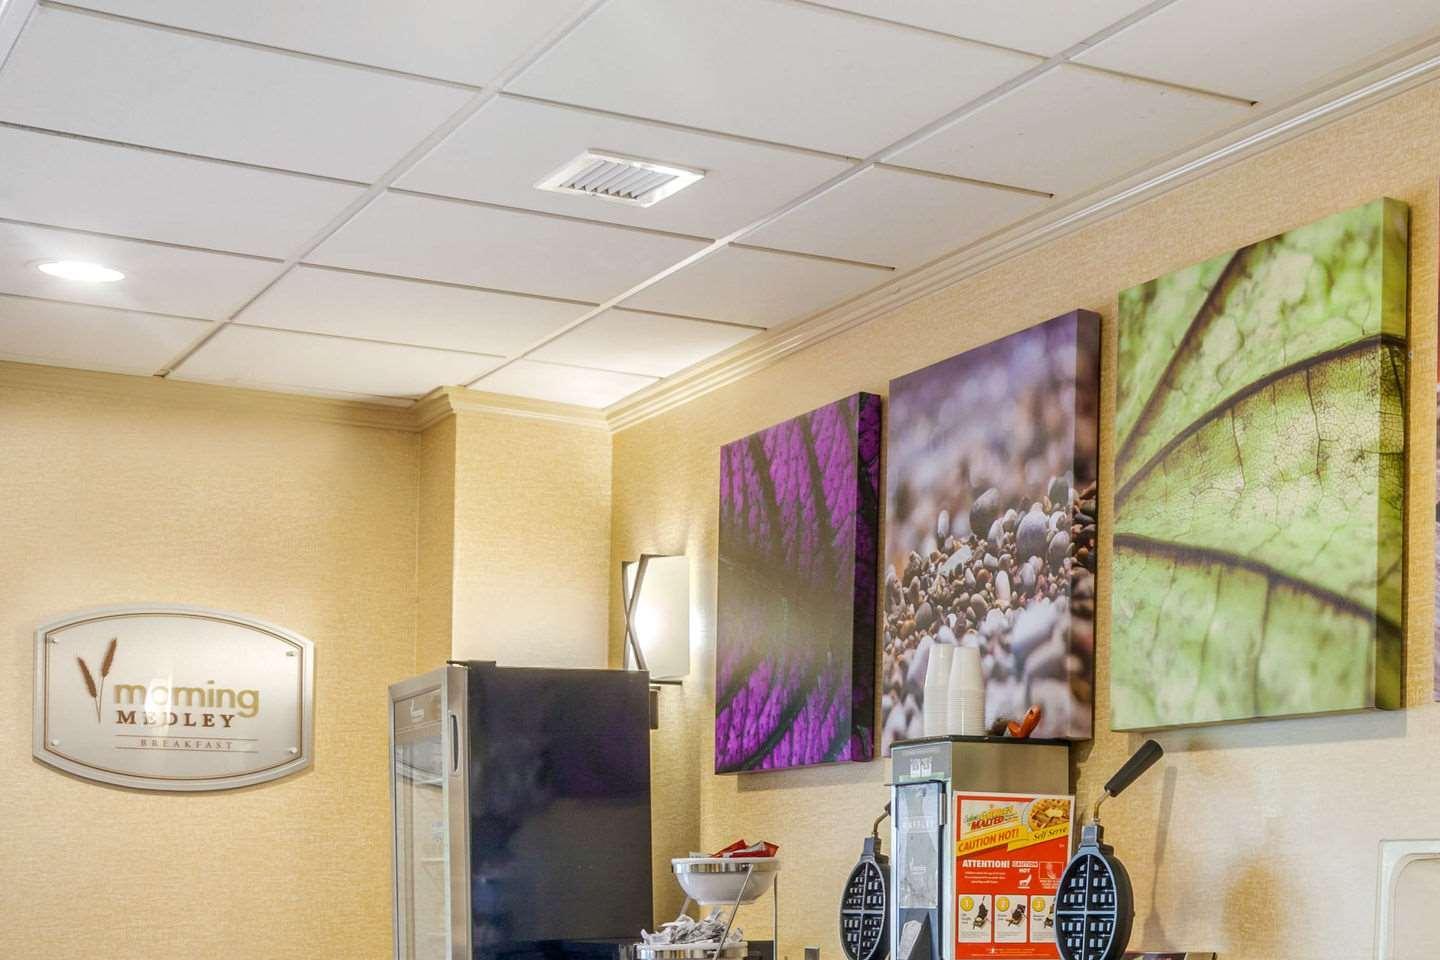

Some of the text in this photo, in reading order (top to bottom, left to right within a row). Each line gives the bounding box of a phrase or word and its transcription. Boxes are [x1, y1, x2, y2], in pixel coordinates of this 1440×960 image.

[116, 709, 235, 728] MEDLEY
[140, 738, 233, 750] BREAKFAST
[957, 828, 1020, 852] CAUTION HOT!
[961, 858, 1010, 869] ATTENTION!
